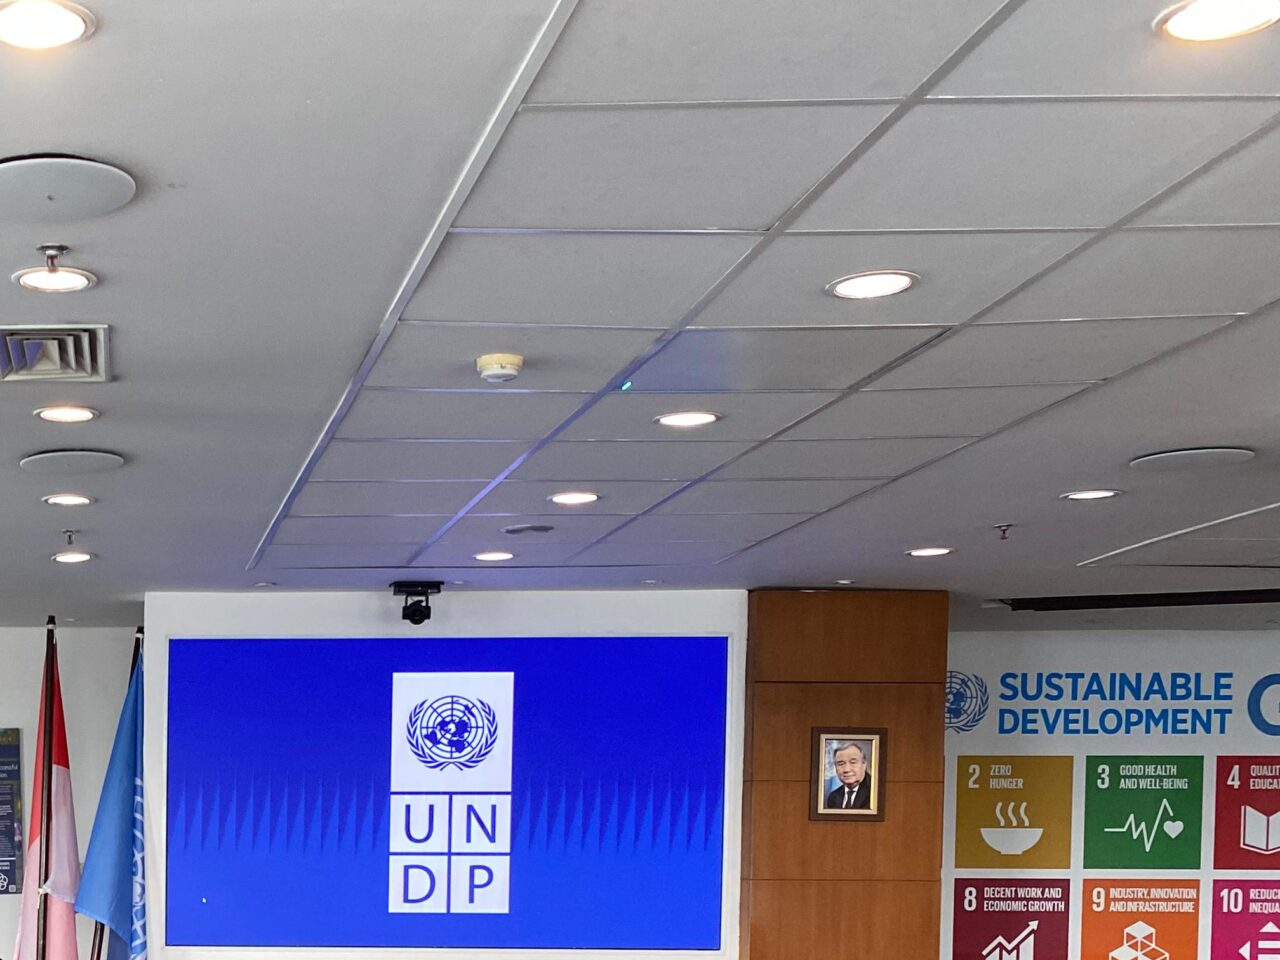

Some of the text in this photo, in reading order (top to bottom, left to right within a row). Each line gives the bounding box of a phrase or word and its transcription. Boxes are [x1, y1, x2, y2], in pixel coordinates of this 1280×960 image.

[999, 672, 1233, 701] SUSTAINABLE
[998, 708, 1232, 735] DEVELOPMENT
[968, 764, 980, 789] 2
[989, 764, 1012, 776] ZERO
[1097, 764, 1110, 789] 3
[1120, 764, 1177, 776] GOOD HEALTH
[1226, 764, 1241, 789] 4
[989, 778, 1024, 789] HUNGER
[1119, 778, 1188, 790] AND WELL-BEING
[963, 886, 977, 911] 8
[984, 887, 1062, 899] DECENT WORK AND
[1092, 887, 1106, 912] 9
[1109, 888, 1196, 899] INDUSTRY, INNOVATION
[1220, 888, 1243, 913] 10
[983, 900, 1065, 912] ECONOMIC GROWTH
[1109, 901, 1195, 913] AND INFRASTRUCTURE
